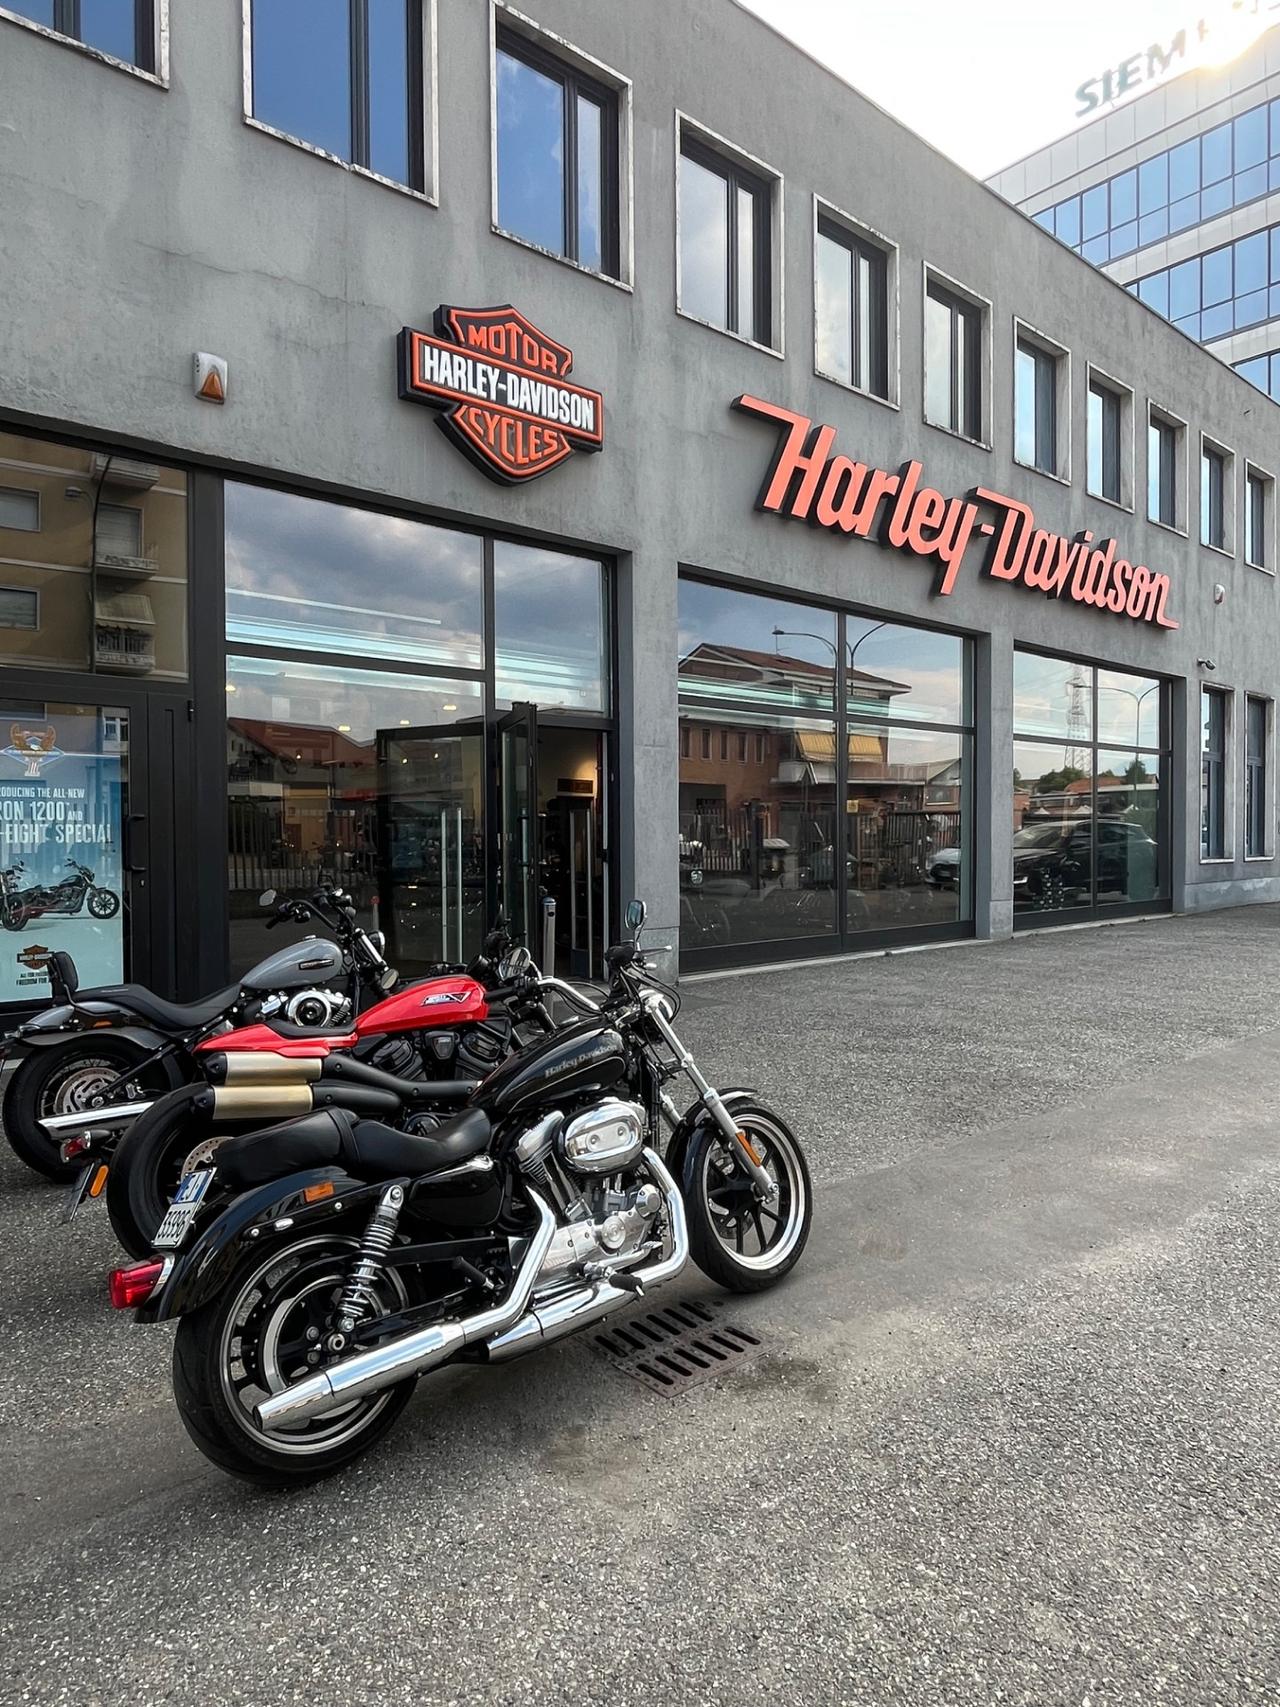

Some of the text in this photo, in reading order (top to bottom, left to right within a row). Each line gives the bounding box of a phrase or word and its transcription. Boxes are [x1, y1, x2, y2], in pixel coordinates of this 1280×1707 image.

[467, 322, 558, 375] MOTOR
[424, 345, 595, 432] HARLEY-DAVIDSON
[468, 407, 558, 465] CYCLES
[734, 394, 1180, 630] Harley-Davidson
[0, 786, 36, 798] ODUCING
[37, 787, 51, 798] THE
[29, 801, 65, 820] 1200
[67, 811, 83, 821] AND
